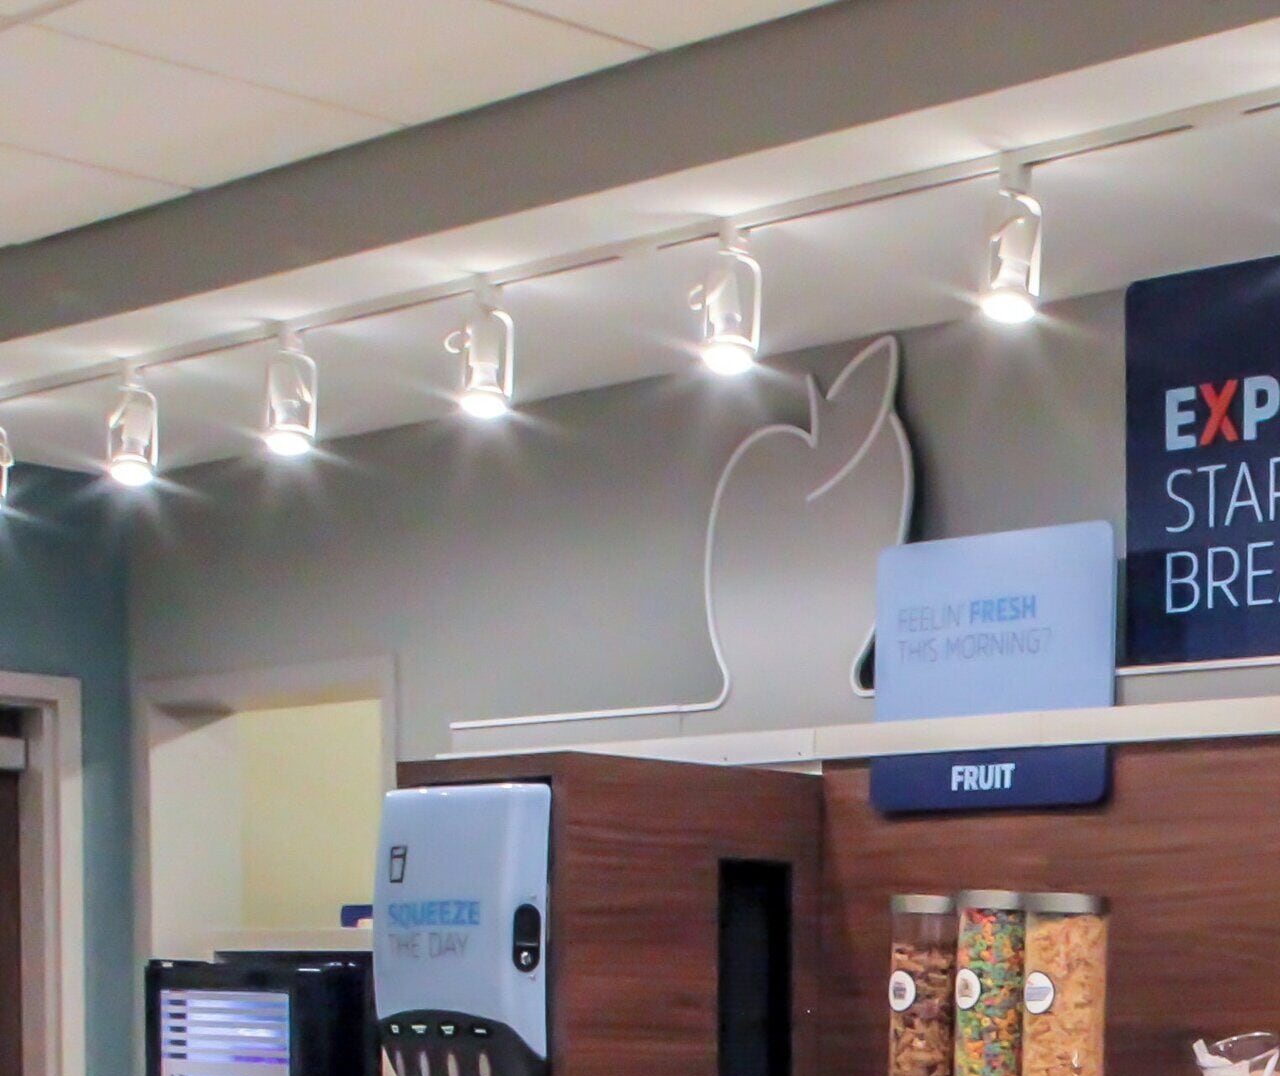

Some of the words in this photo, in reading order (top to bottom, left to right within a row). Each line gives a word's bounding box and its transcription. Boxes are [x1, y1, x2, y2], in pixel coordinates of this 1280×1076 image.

[970, 595, 1037, 624] FRESH
[898, 639, 938, 664] THIS
[946, 627, 1052, 661] MORNING?
[951, 763, 1016, 791] FRUIT
[388, 900, 480, 929] SQUEEZE
[388, 932, 421, 959] THE
[428, 932, 470, 959] DAY
